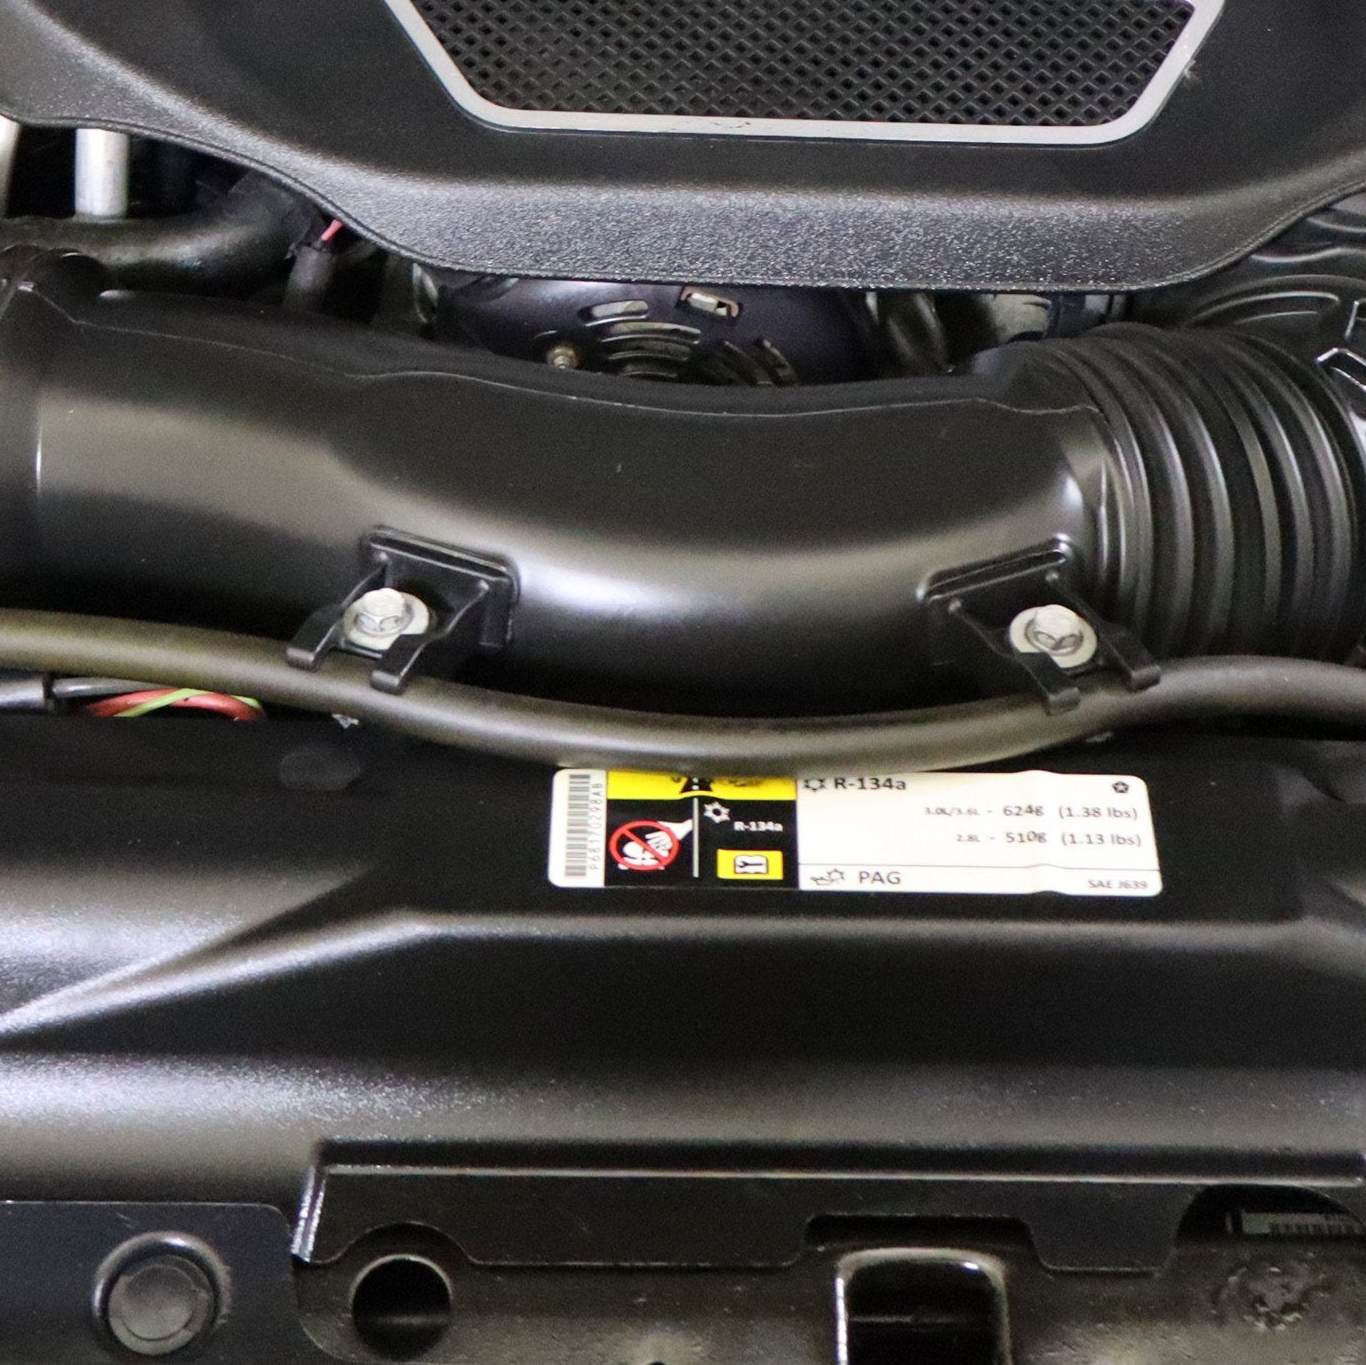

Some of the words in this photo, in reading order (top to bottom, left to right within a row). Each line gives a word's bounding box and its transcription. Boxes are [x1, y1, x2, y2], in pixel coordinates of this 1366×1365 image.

[835, 776, 908, 792] R-134a
[1002, 803, 1045, 819] 624g
[1058, 805, 1103, 820] (1.38
[1107, 806, 1139, 821] lbs)
[733, 820, 784, 833] R-134a
[1061, 832, 1105, 847] (1.13
[1110, 832, 1142, 848] lbs)
[858, 870, 903, 886] PAG
[1087, 877, 1114, 890] SAE
